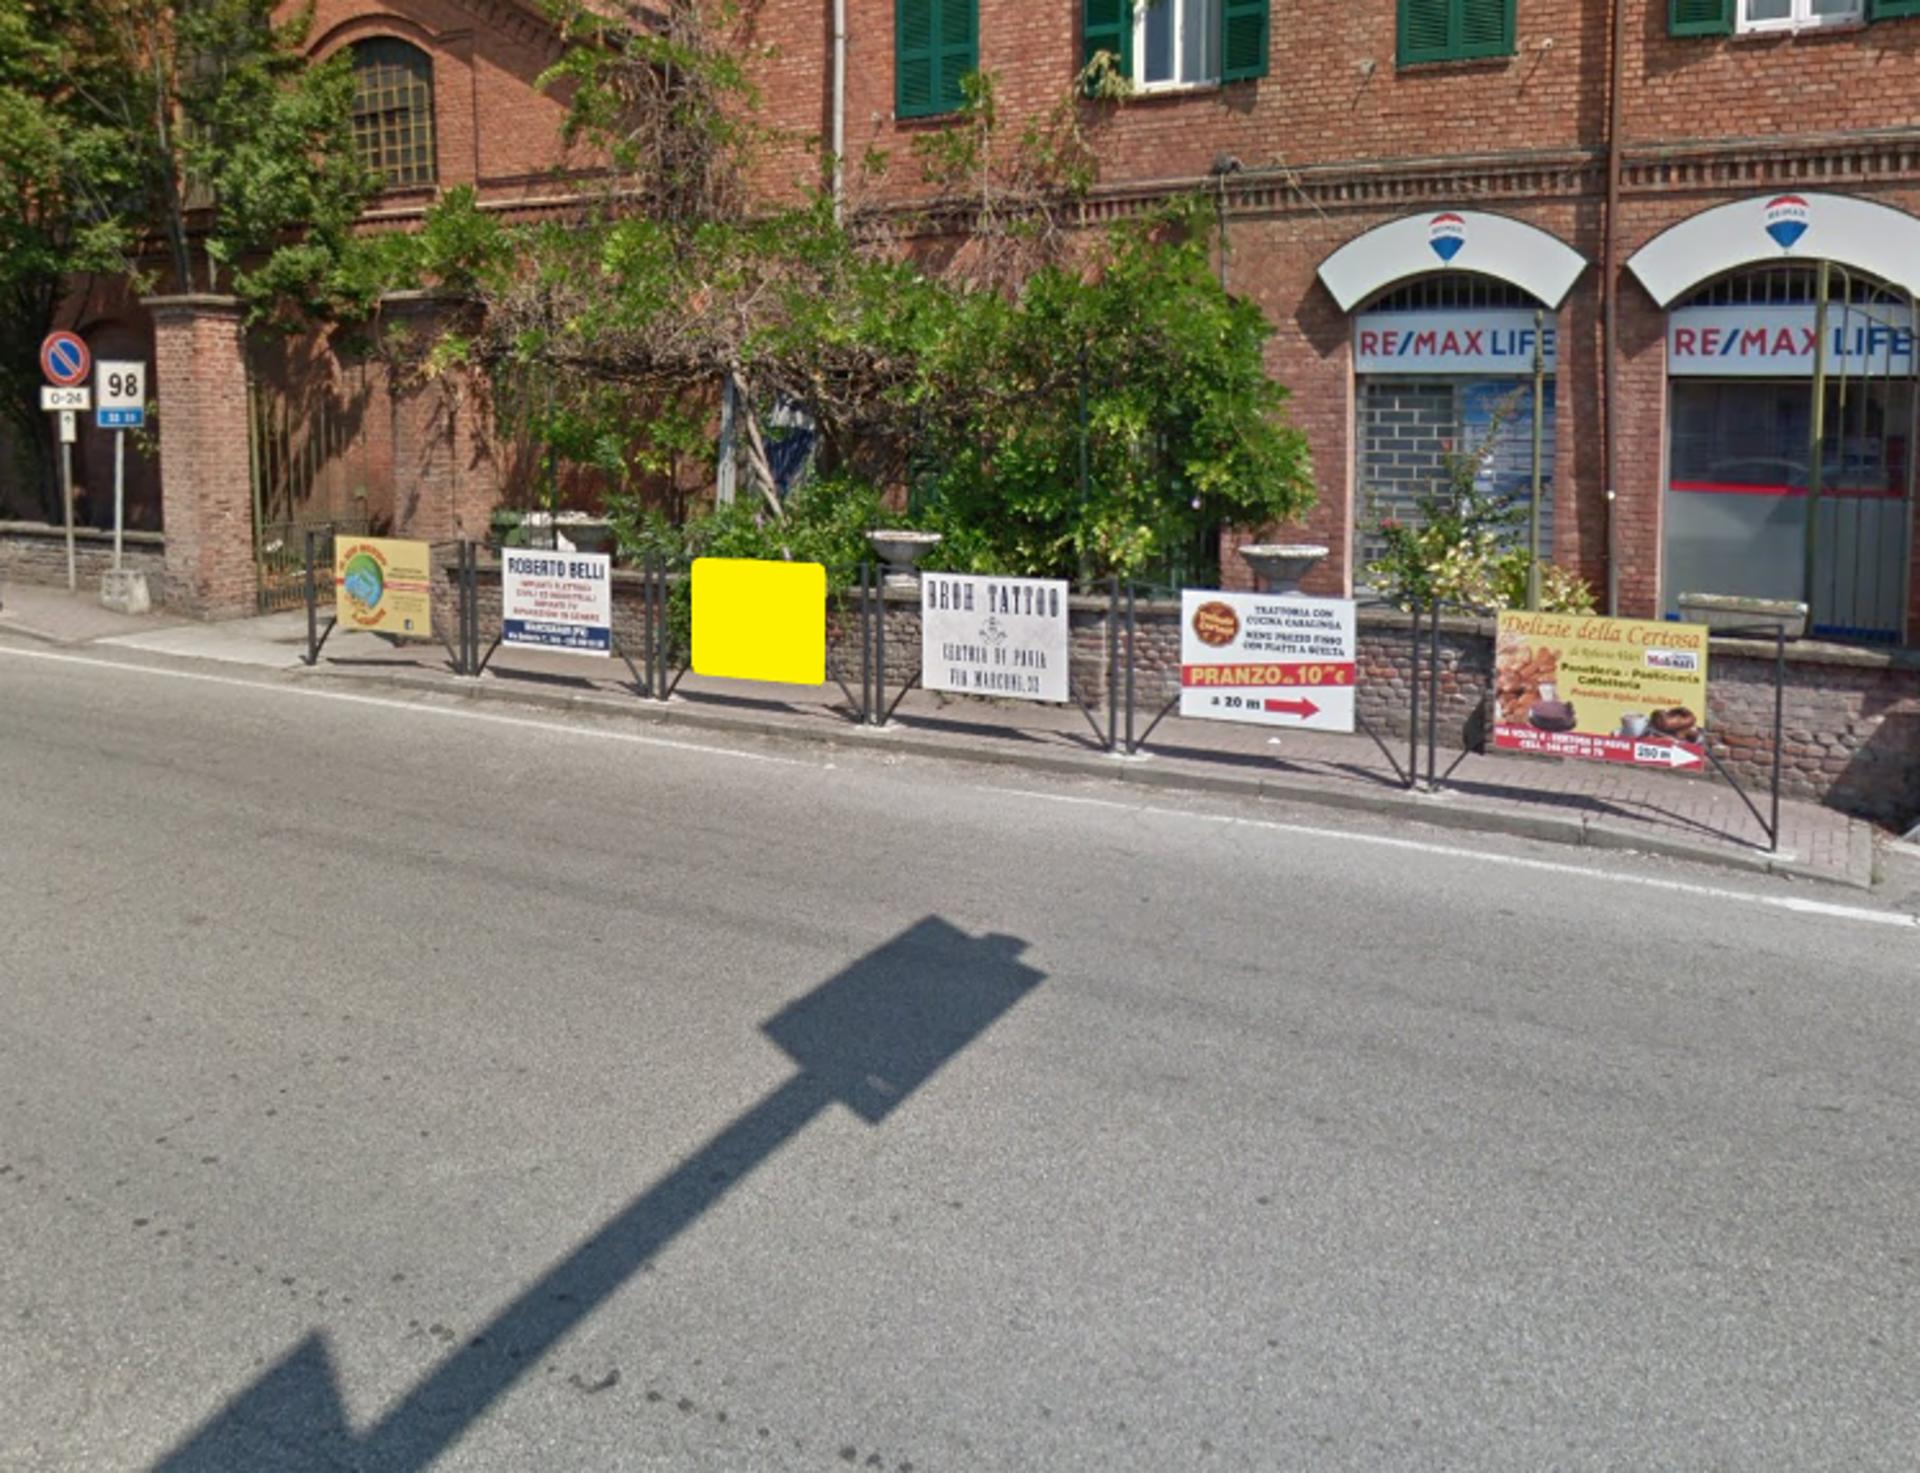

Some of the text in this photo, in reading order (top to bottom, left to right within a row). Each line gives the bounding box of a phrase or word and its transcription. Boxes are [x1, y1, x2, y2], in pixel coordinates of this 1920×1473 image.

[1360, 328, 1556, 356] RE/MAX LIFE
[1675, 326, 1912, 356] RE/MAX LIFE
[108, 372, 137, 398] 98
[50, 392, 83, 405] 0-24
[508, 557, 605, 580] ROBERTO BELLI
[987, 583, 1059, 618] TATTOO
[1254, 606, 1335, 618] TRATTORIA CON
[1502, 614, 1701, 650] Delizie della Certosa
[1190, 666, 1283, 686] PRANZO
[1224, 695, 1243, 708] 20
[1246, 698, 1261, 711] m
